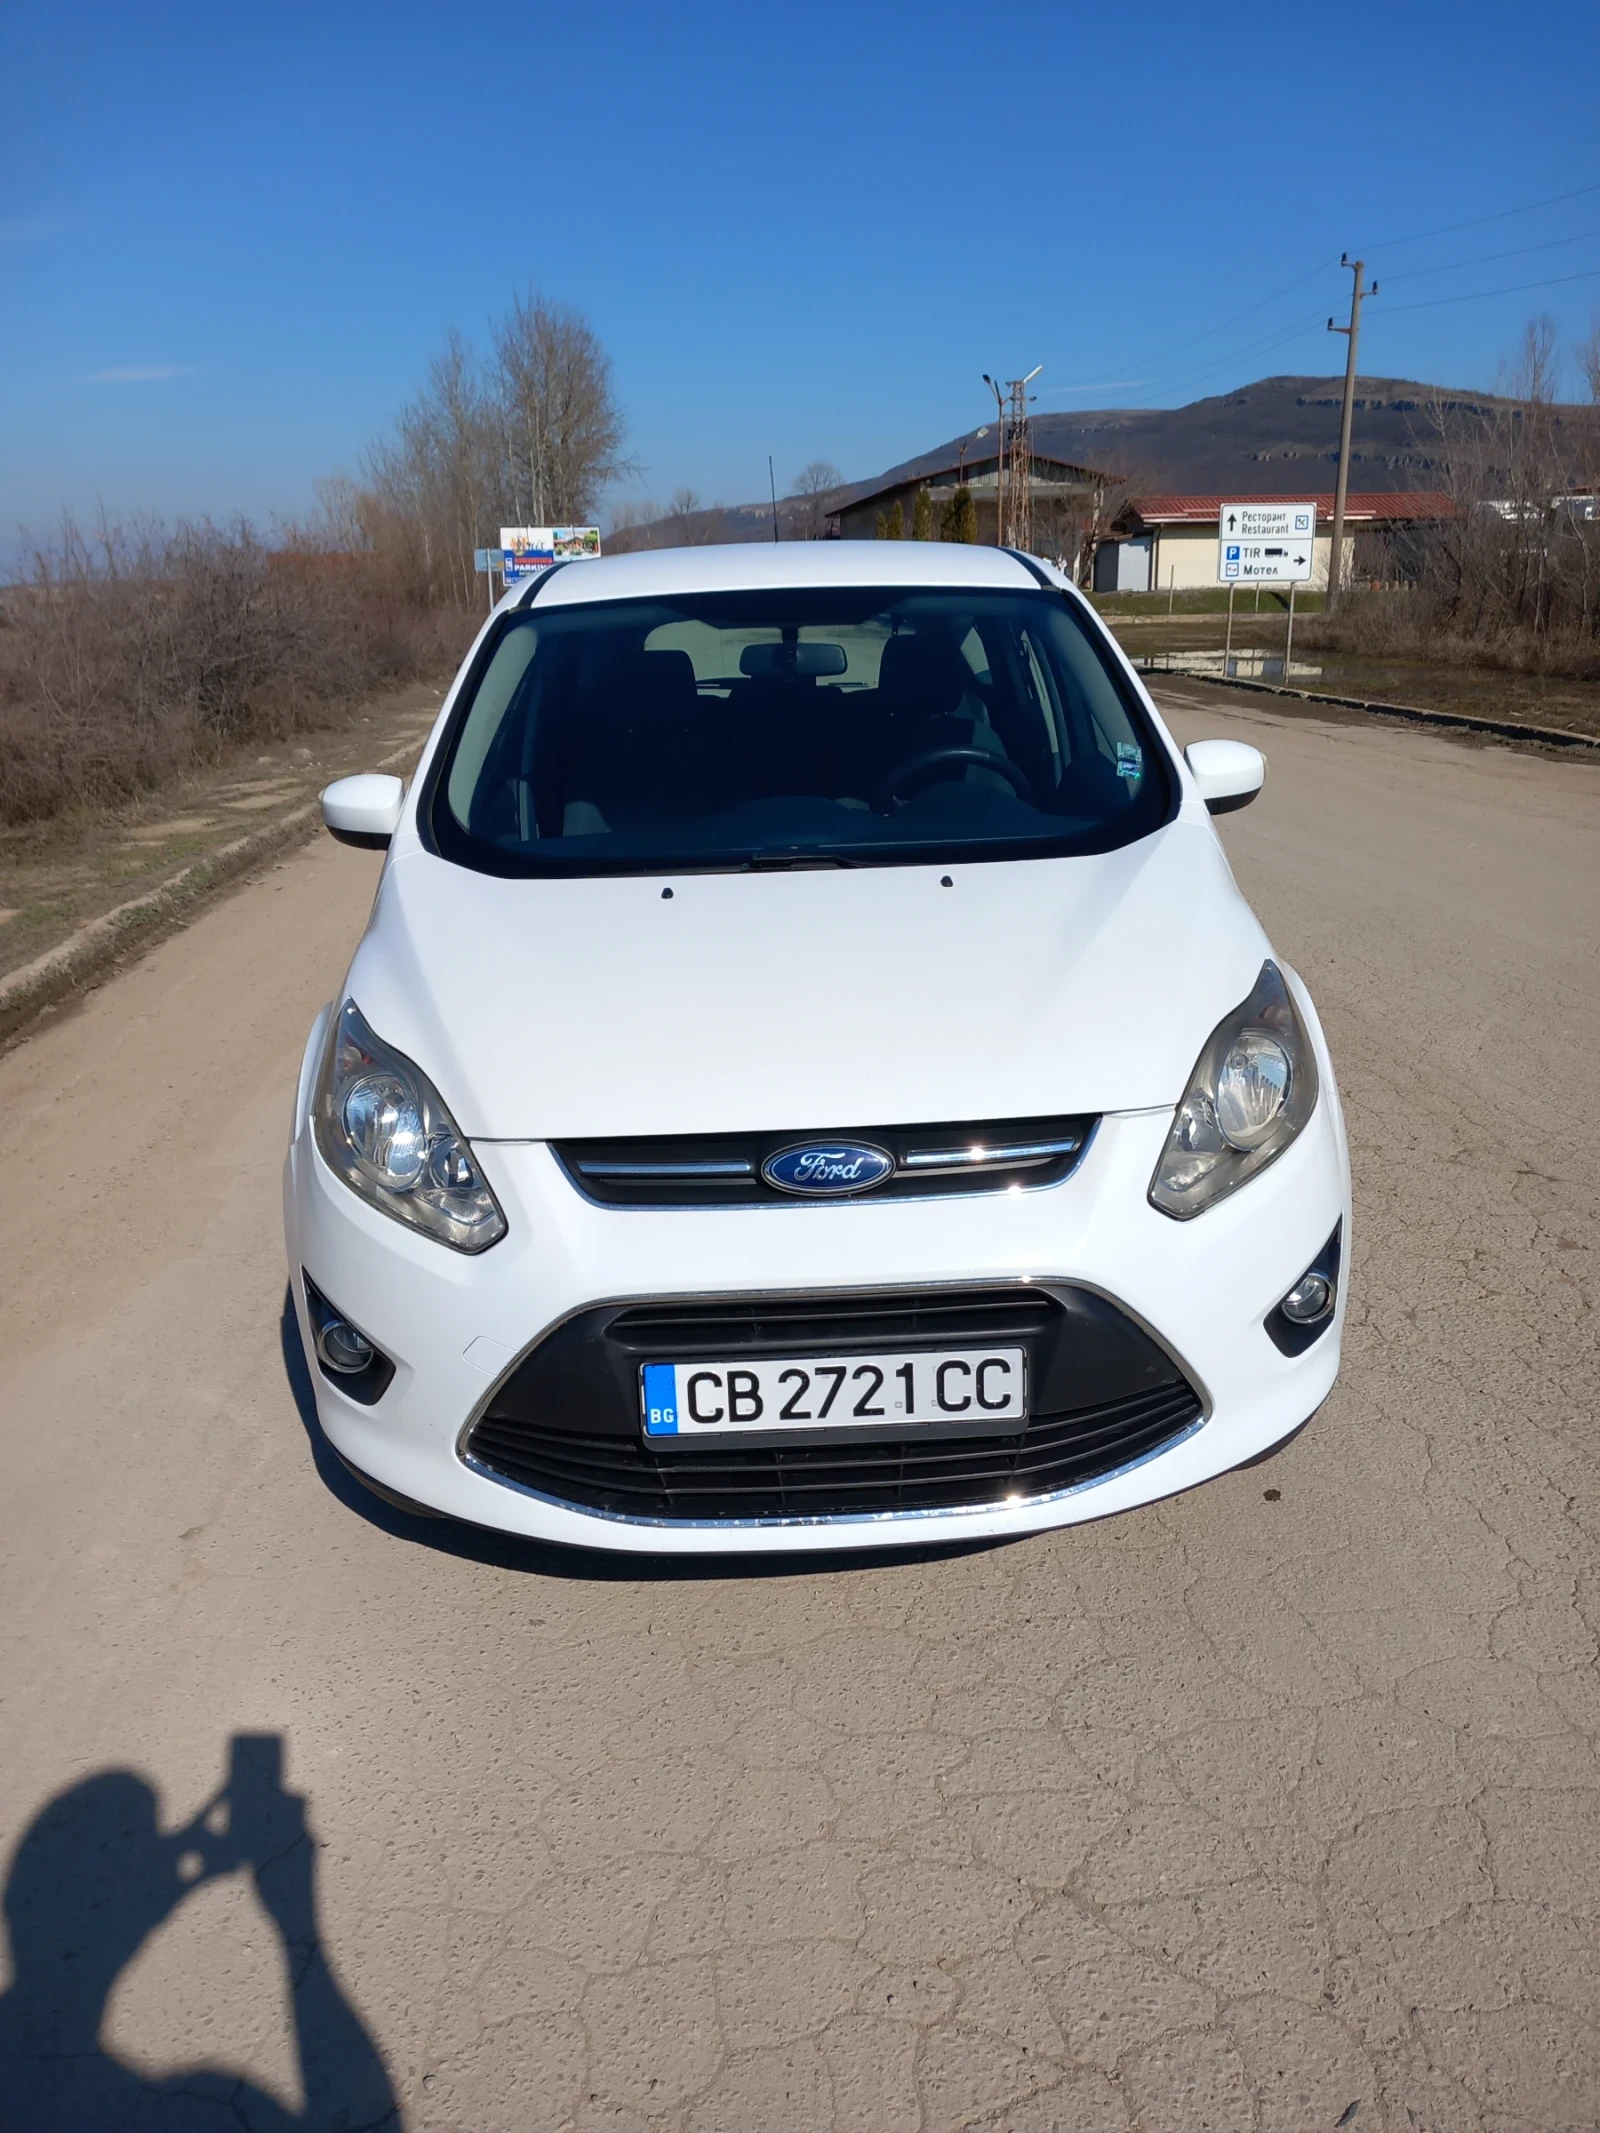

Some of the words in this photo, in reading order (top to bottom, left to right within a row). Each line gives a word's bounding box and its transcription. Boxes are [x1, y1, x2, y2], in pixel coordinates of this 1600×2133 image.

[1242, 511, 1286, 523] Ресторант
[1242, 523, 1289, 534] Restaurant
[1229, 547, 1237, 559] P
[1243, 547, 1260, 558] TIR
[514, 563, 549, 571] PARKIN
[1243, 565, 1278, 575] Мотел
[794, 1152, 865, 1181] Ford
[687, 1370, 764, 1424] CB
[778, 1362, 915, 1420] 2721
[936, 1357, 1012, 1412] CC
[650, 1408, 674, 1424] BG
